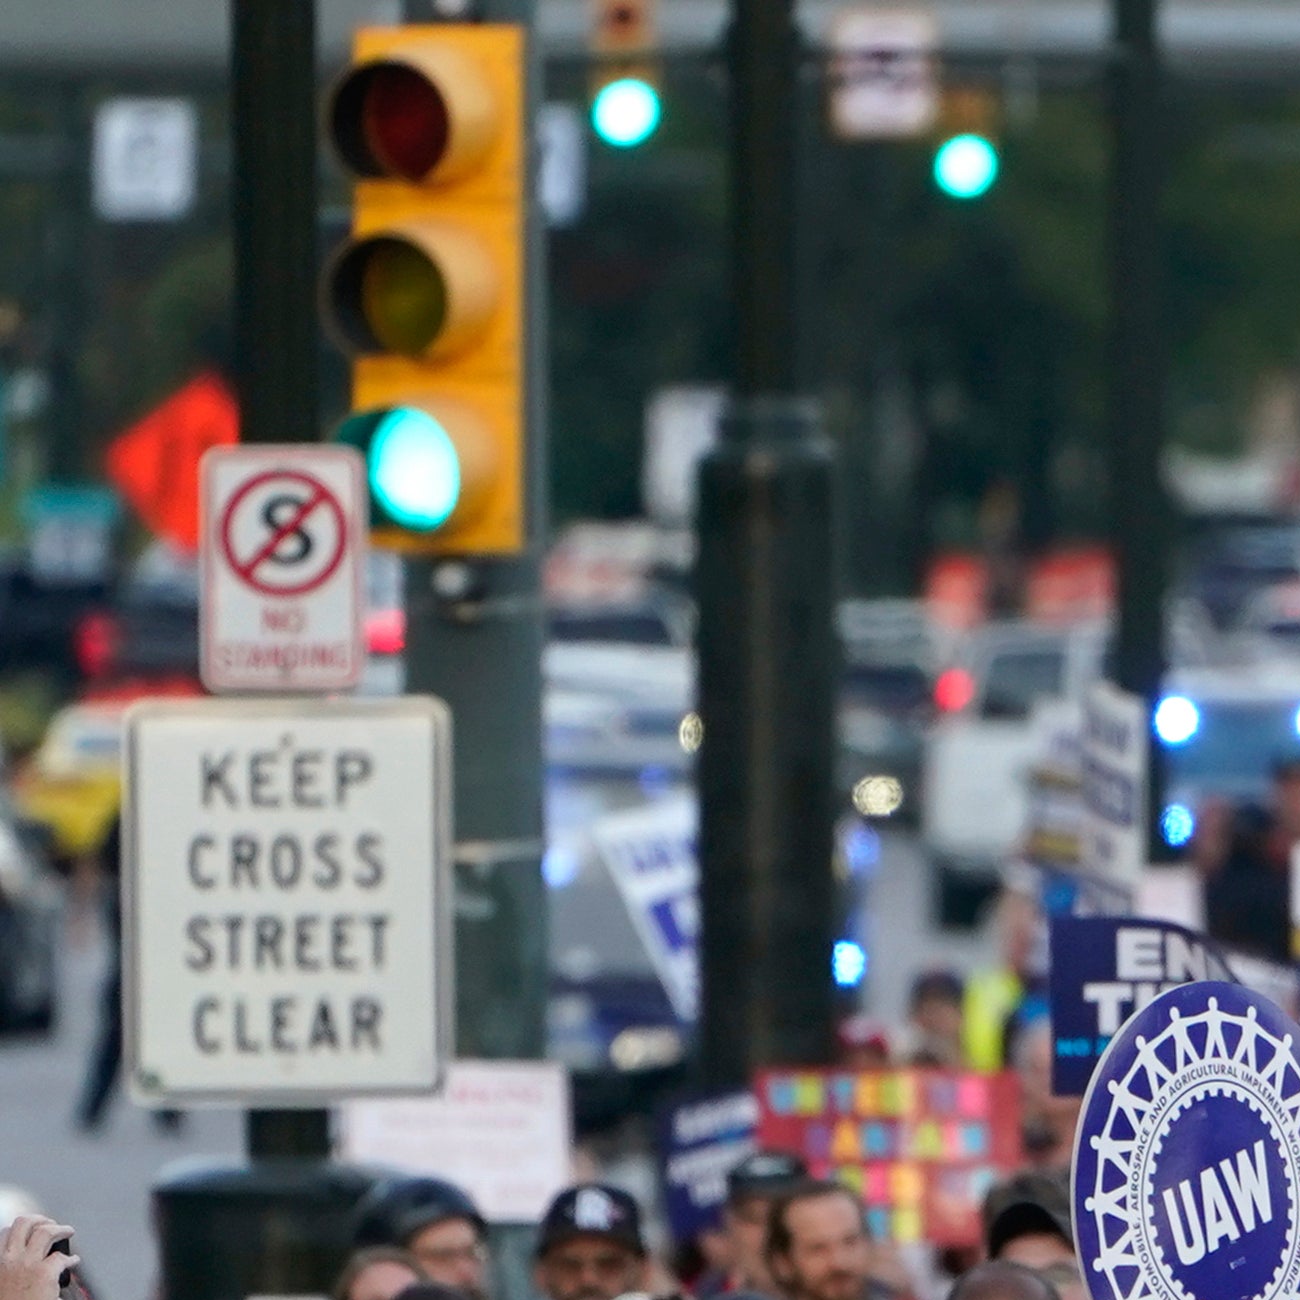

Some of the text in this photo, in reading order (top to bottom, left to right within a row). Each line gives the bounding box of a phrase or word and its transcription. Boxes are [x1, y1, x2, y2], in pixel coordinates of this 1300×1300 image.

[199, 749, 375, 809] KEEP
[187, 833, 386, 891] CROSS
[185, 915, 390, 972] STREET
[1116, 926, 1212, 982] EN
[193, 996, 384, 1053] CLEAR
[1130, 1127, 1151, 1212] AEROSPACE
[1149, 1095, 1168, 1124] AND
[1169, 1063, 1238, 1097] AGRICULTURAL
[1241, 1071, 1289, 1126] IMPLEMENT
[1162, 1139, 1273, 1267] UAW
